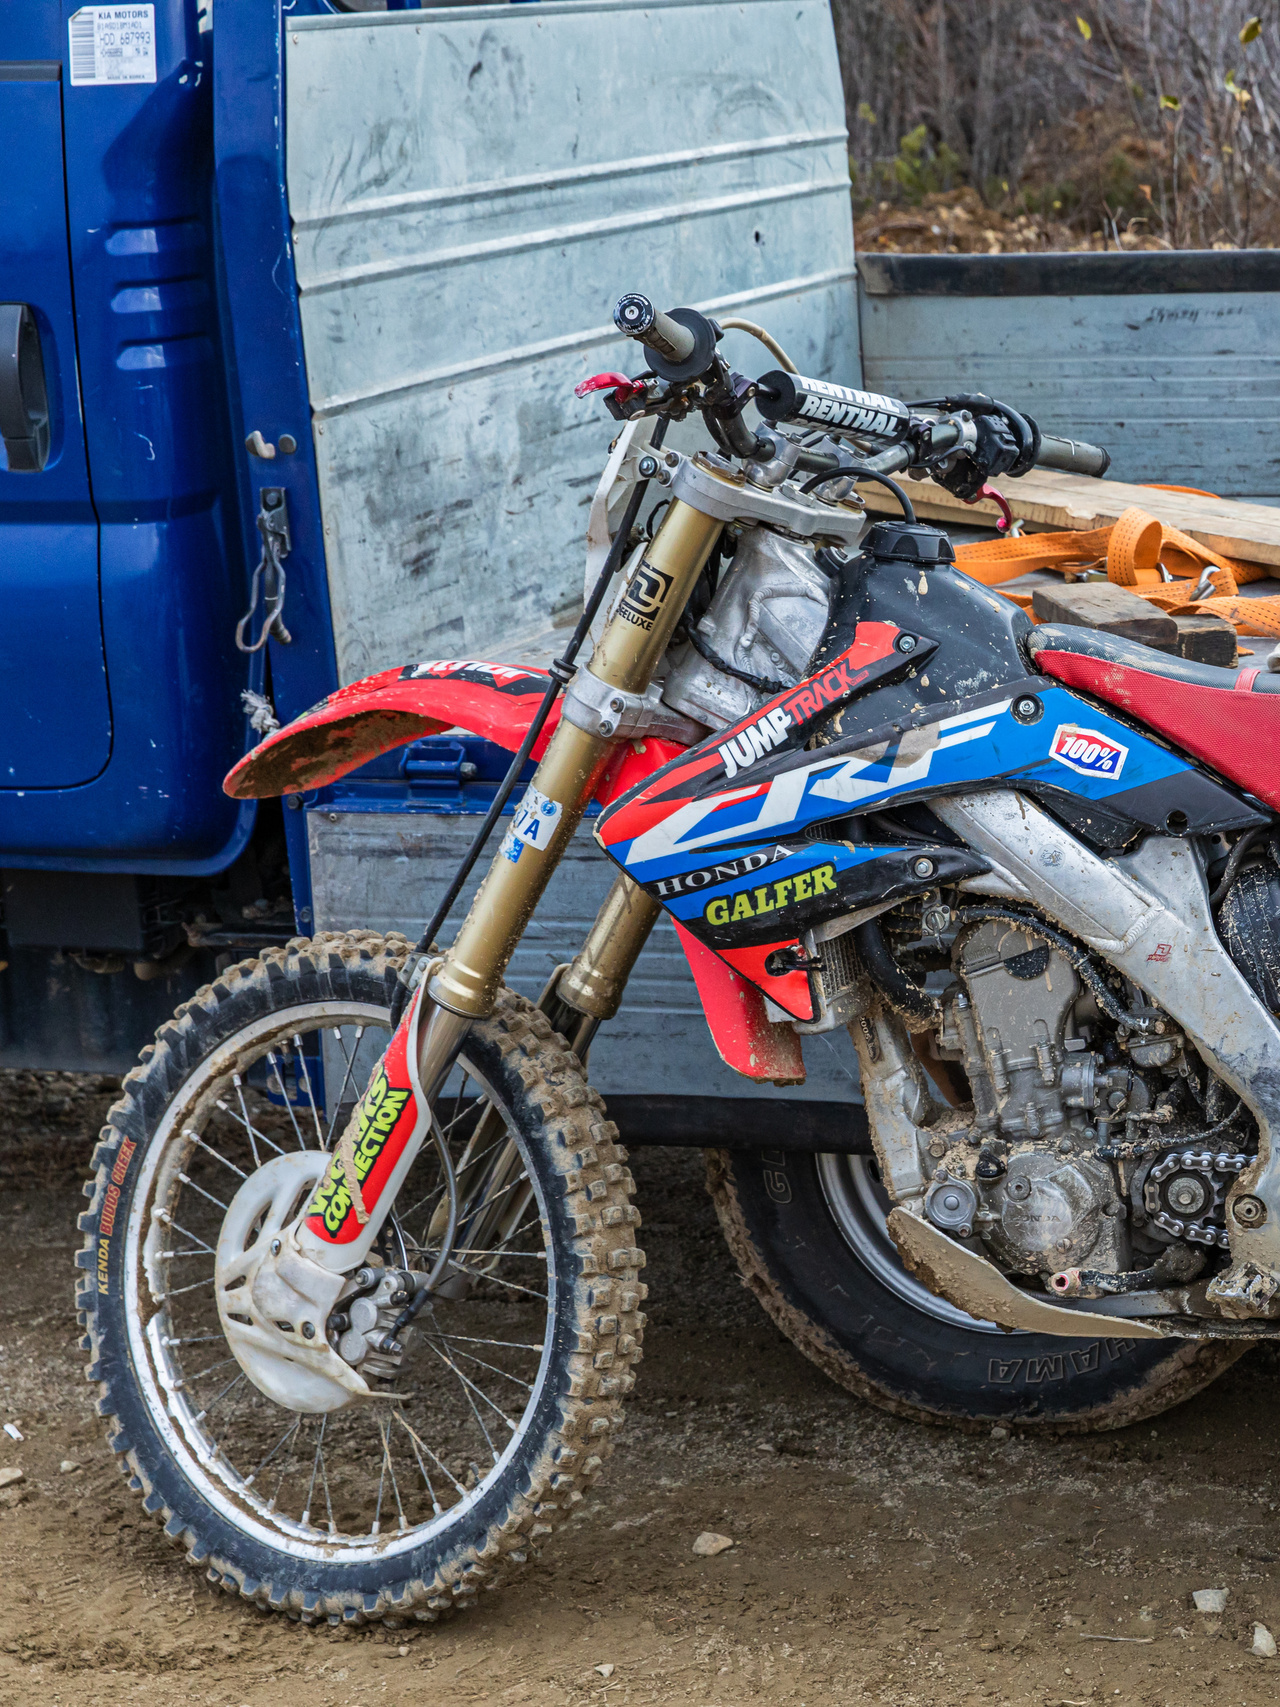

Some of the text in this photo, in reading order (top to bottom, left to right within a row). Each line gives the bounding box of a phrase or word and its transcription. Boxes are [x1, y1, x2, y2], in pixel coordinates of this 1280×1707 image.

[114, 10, 149, 18] MOTORS
[799, 395, 899, 438] RENTHAL
[800, 376, 900, 413] RENTHAL
[1060, 735, 1114, 772] 100%
[625, 698, 1016, 866] CRF
[656, 843, 797, 897] HONDA
[705, 865, 838, 927] GALFER
[98, 1135, 138, 1296] KENDA BUDDS CREEK
